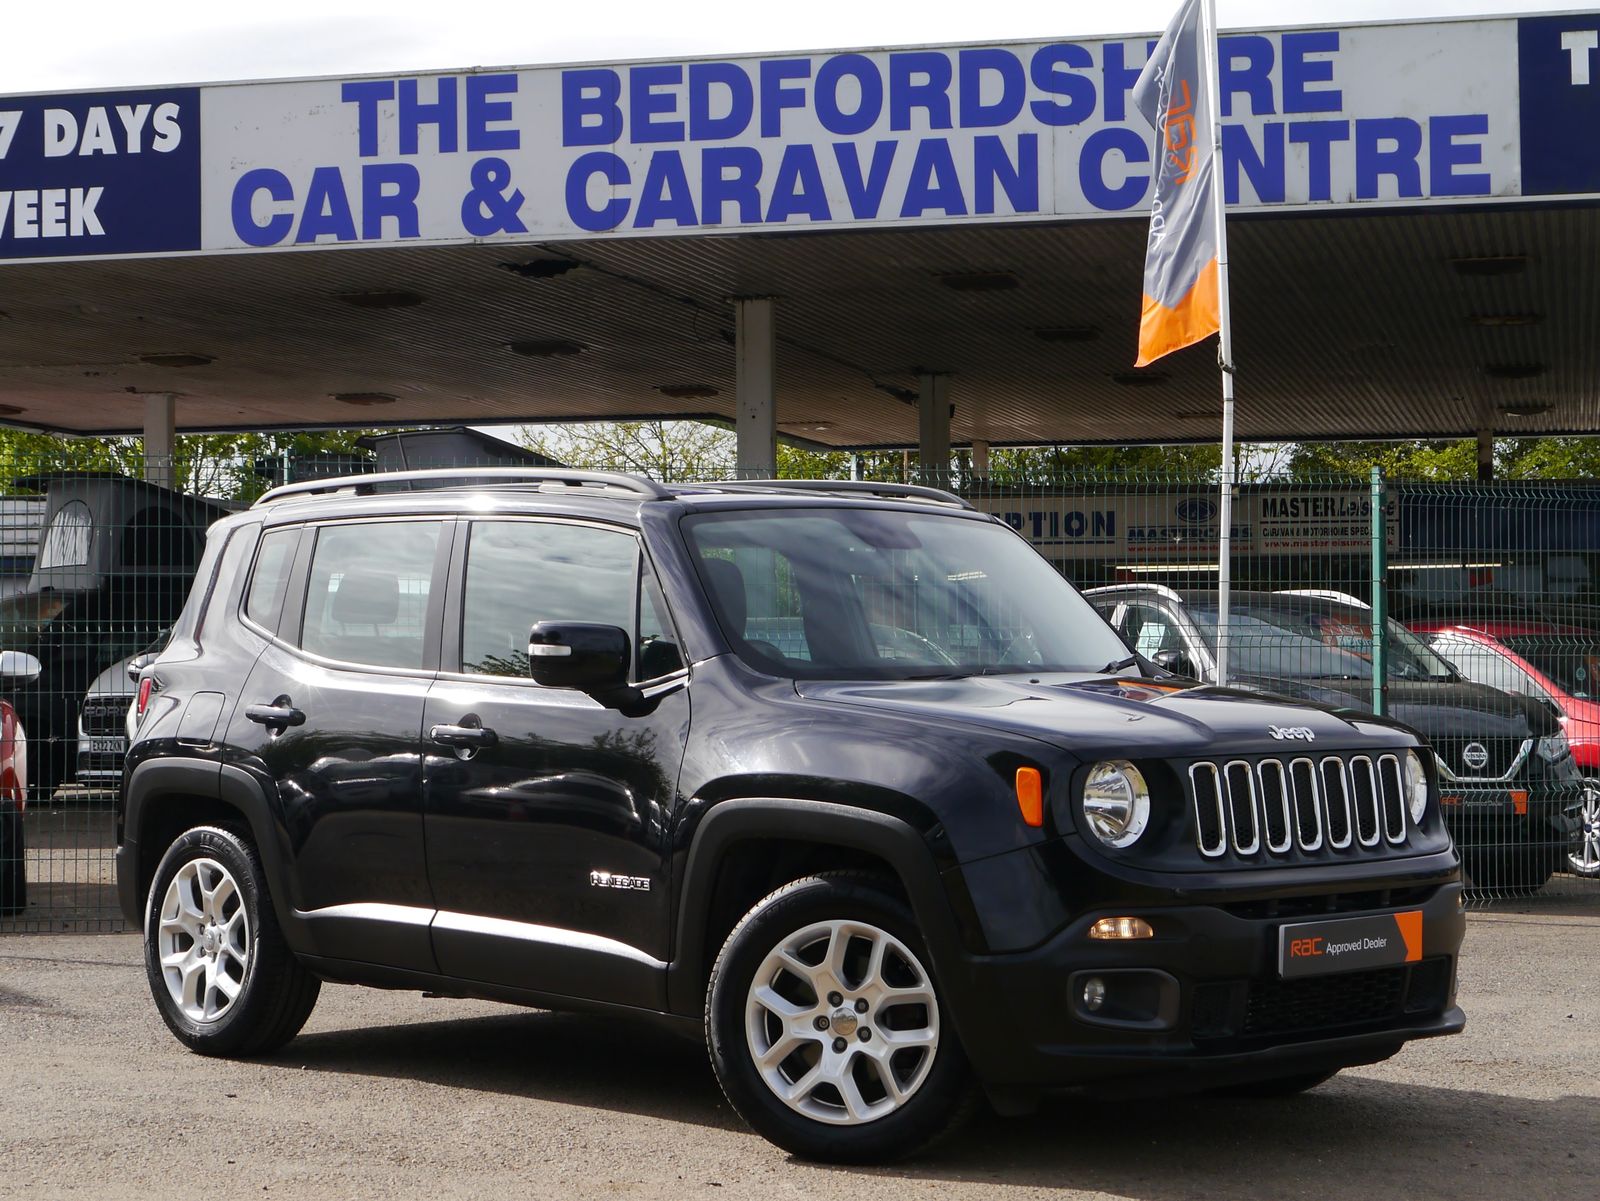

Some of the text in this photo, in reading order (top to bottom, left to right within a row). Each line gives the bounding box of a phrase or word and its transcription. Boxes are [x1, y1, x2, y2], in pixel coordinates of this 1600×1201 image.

[341, 74, 520, 157] THE
[562, 31, 1342, 147] BEDFORDSHRE
[0, 102, 182, 160] 7 DAYS
[231, 114, 1491, 247] CAR & CARAVAN CNTRE
[0, 187, 105, 240] EEK
[988, 511, 1116, 537] PTION
[1128, 527, 1253, 541] MASTERCRS
[1262, 527, 1295, 537] CARAVAN
[1268, 725, 1315, 743] Jeep
[590, 870, 651, 891] RENEGADE
[1326, 939, 1362, 955] Approved
[1363, 937, 1388, 950] Dealer
